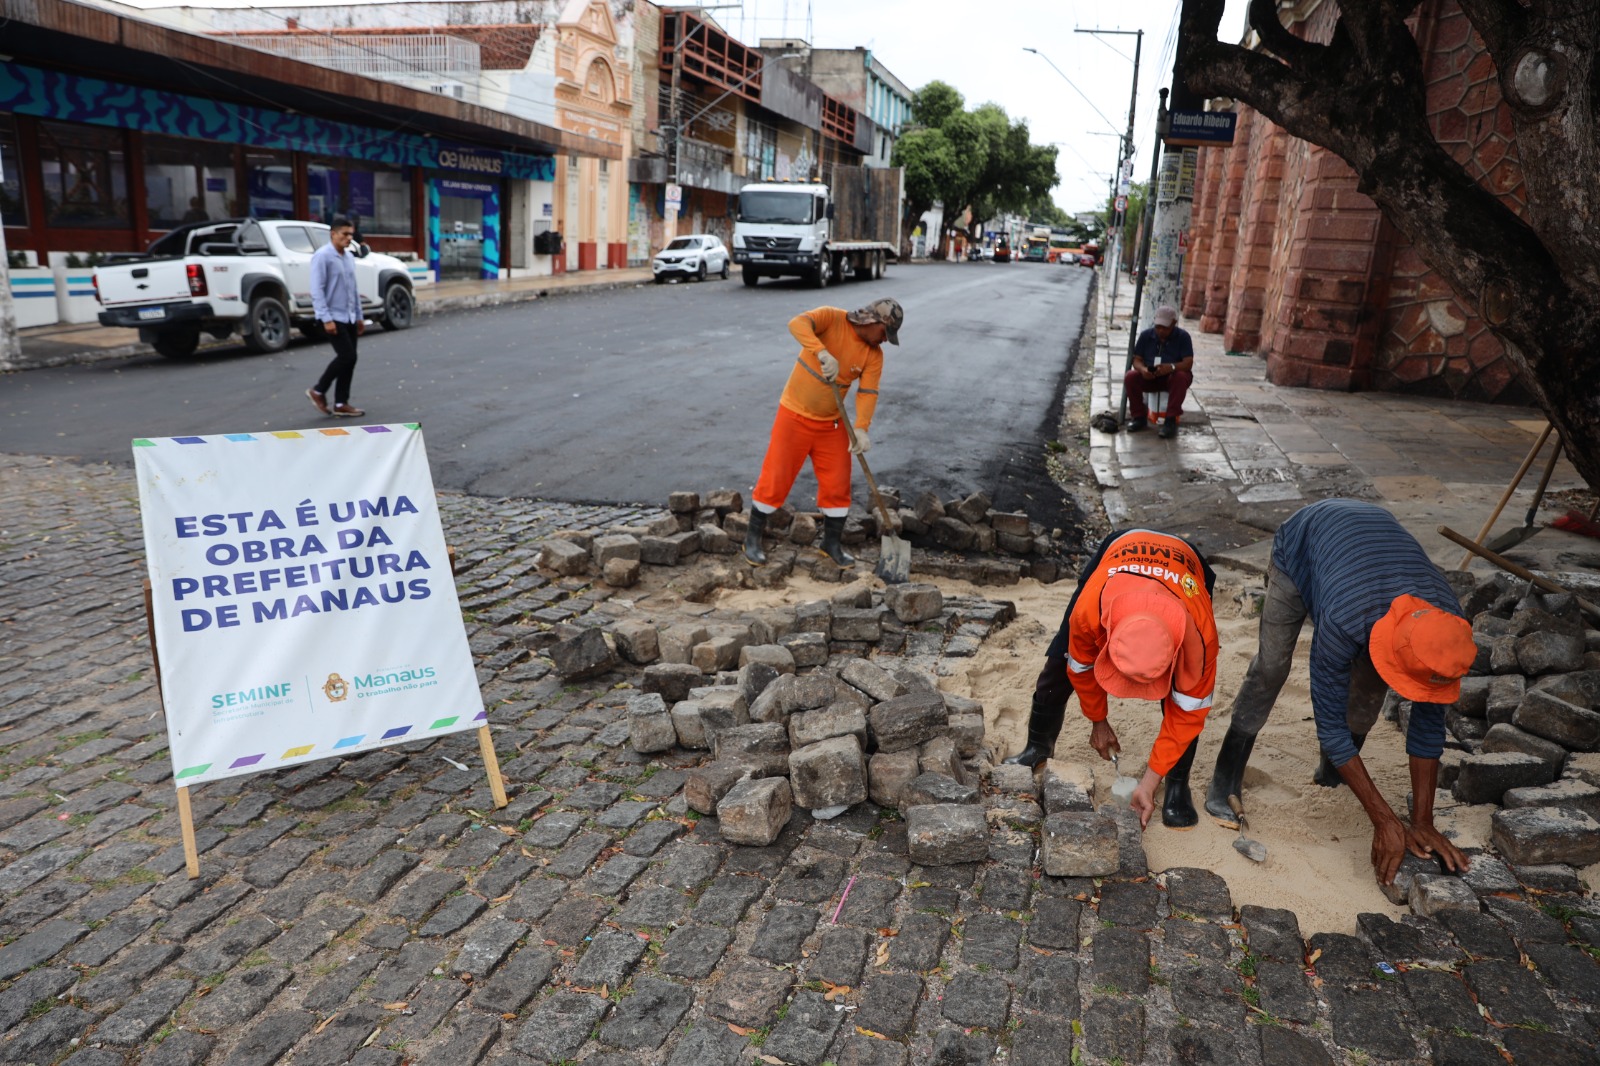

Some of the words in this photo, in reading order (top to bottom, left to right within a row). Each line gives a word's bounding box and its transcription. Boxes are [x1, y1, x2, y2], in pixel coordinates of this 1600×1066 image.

[1173, 112, 1203, 127] Eduardo
[1203, 114, 1231, 129] Ribeiro
[458, 153, 502, 174] MANAUS
[174, 509, 287, 539] ESTA
[296, 498, 319, 527] É
[328, 495, 419, 523] UMA
[205, 534, 328, 566] OBRA
[336, 525, 393, 550] DA
[1121, 557, 1169, 567] Prefeitura
[172, 549, 431, 601] PREFEITURA
[180, 604, 241, 633] DE
[251, 578, 432, 624] MANAUS
[353, 666, 436, 690] Manaus
[365, 686, 402, 698] trabalho
[403, 683, 419, 691] não
[419, 679, 438, 689] para
[211, 682, 292, 709] SEMINF
[212, 704, 249, 717] Secretaria
[250, 698, 284, 709] Municipal
[213, 710, 265, 725] Infraestrutura
